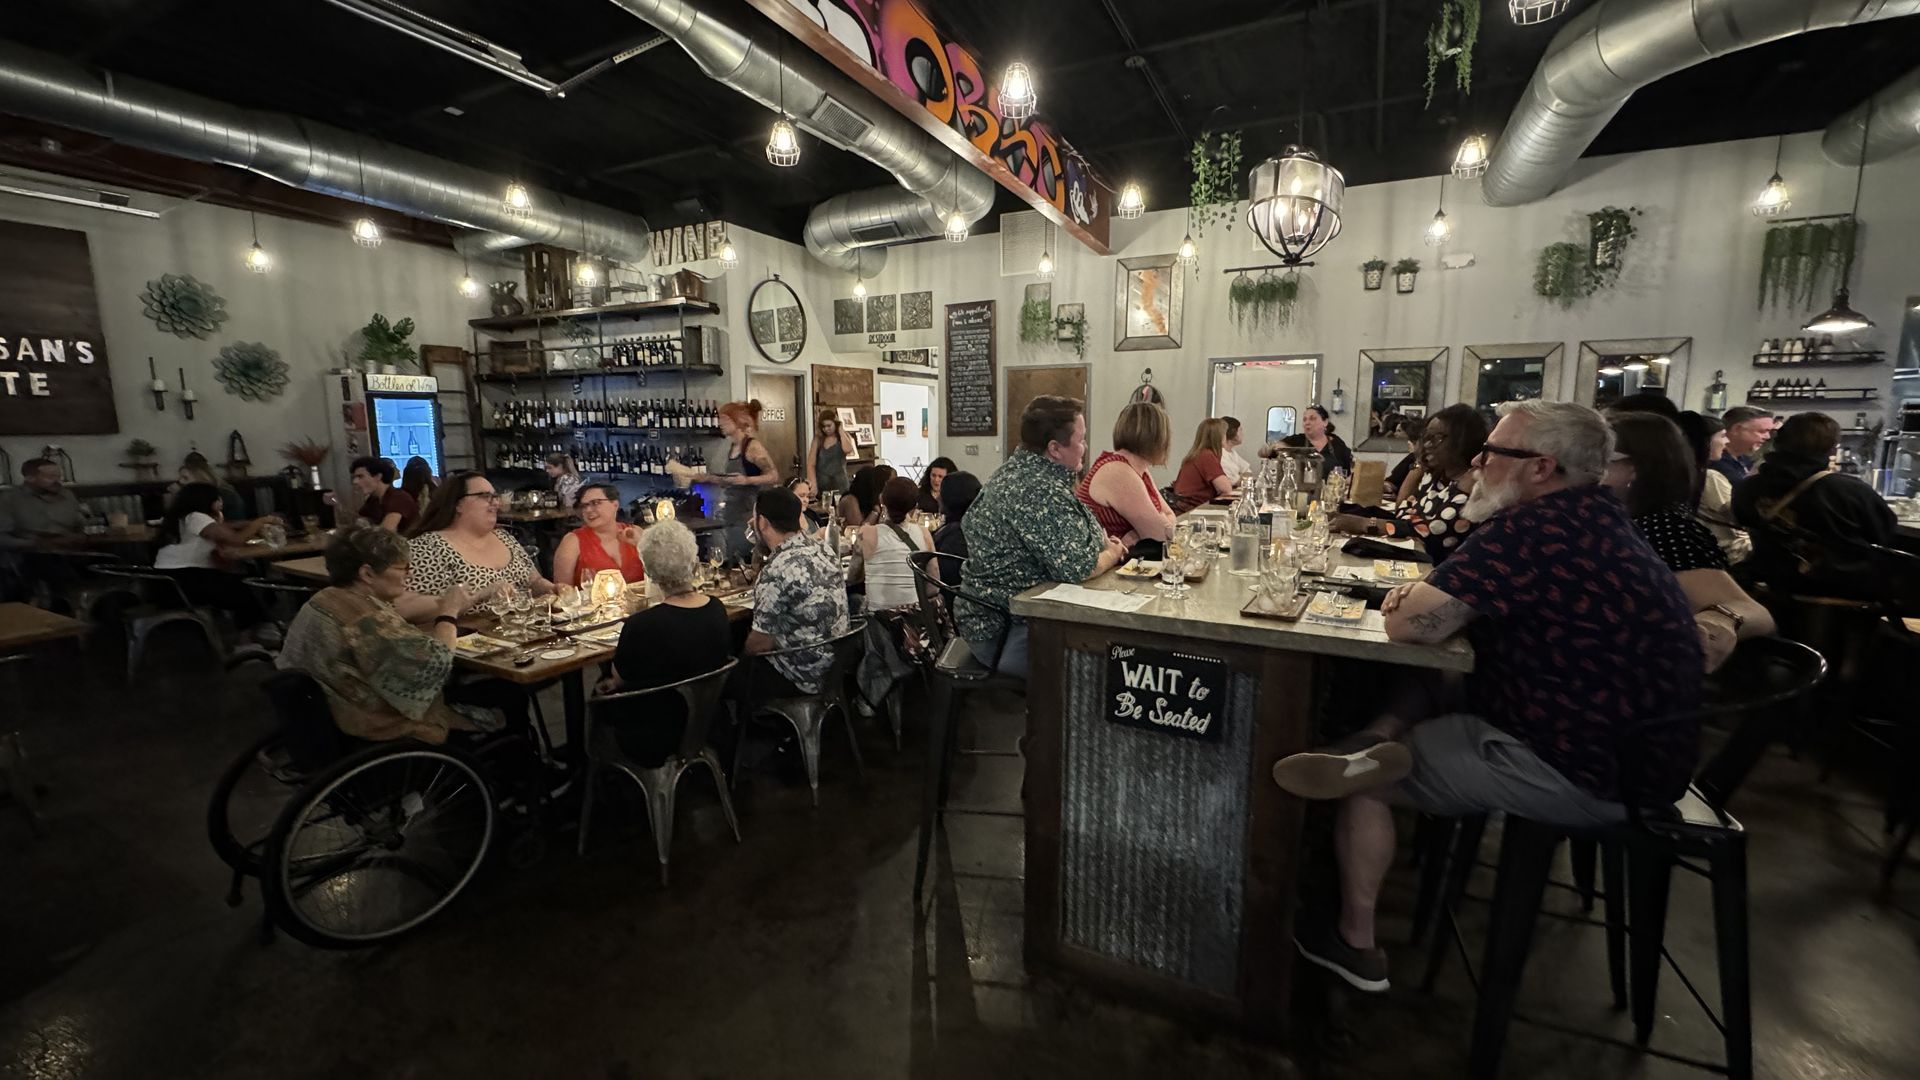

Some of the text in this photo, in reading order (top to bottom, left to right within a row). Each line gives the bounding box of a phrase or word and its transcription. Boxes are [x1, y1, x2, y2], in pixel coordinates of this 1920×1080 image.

[647, 219, 724, 267] WINE
[372, 375, 405, 390] Bottles
[761, 408, 785, 421] OFFICE
[1111, 645, 1136, 660] Please
[1121, 661, 1210, 701] WAIT to
[1114, 691, 1212, 735] Be Seated
